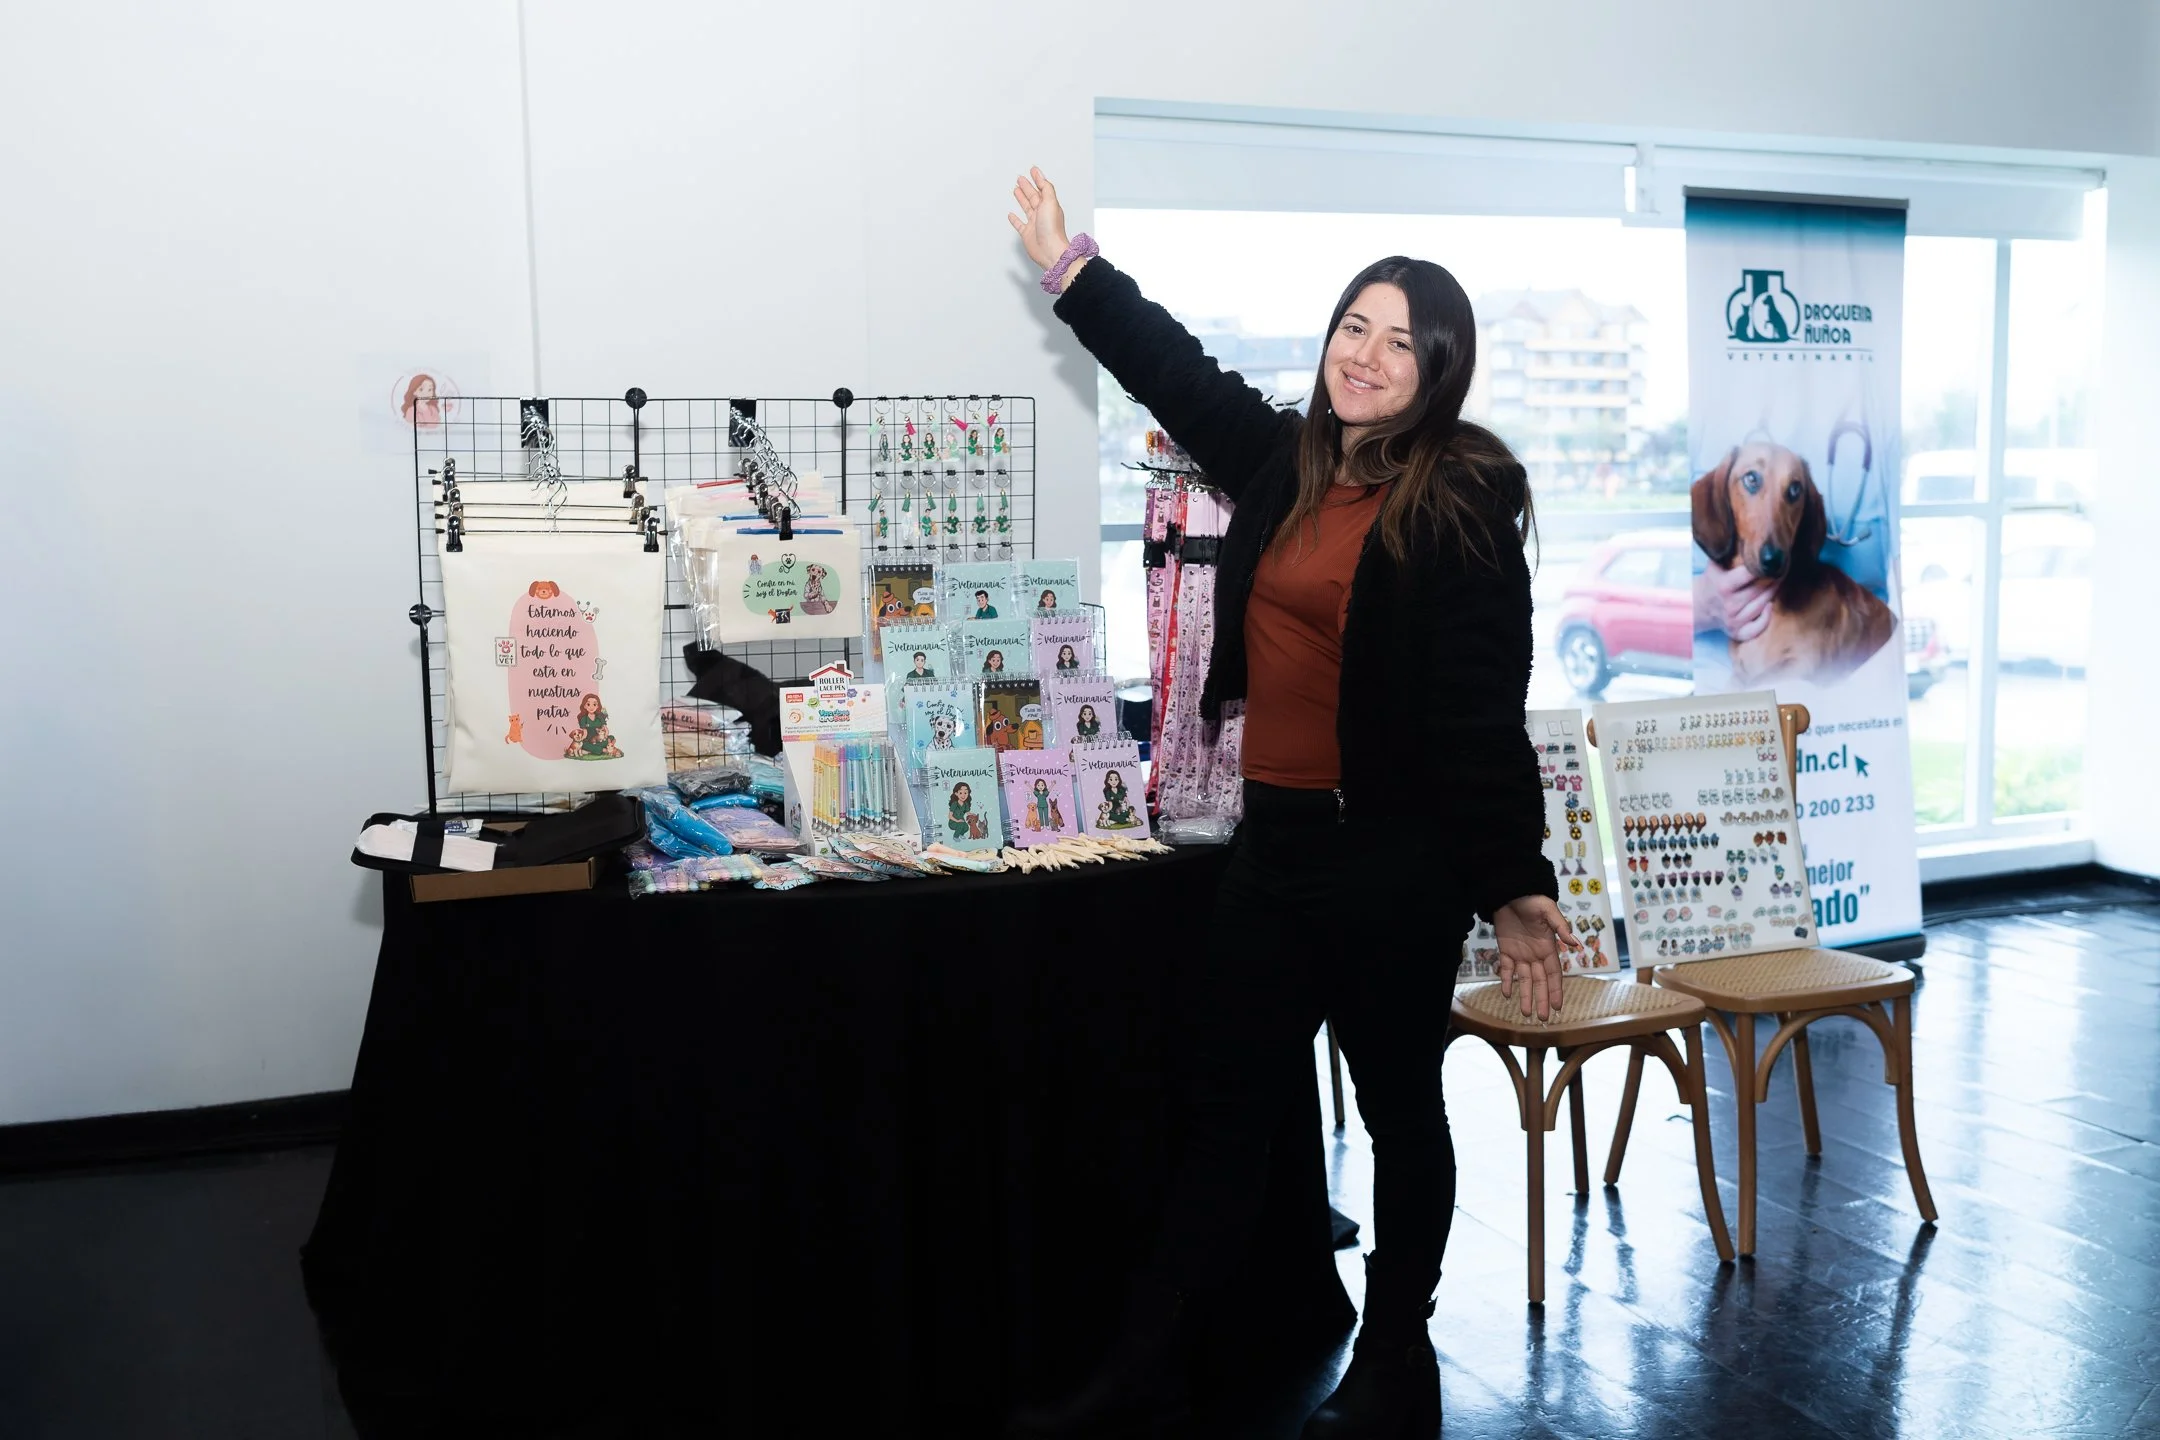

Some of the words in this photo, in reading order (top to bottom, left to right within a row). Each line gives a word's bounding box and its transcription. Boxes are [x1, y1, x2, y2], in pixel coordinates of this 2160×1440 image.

[1805, 324, 1851, 344] ÑUÑOA
[958, 581, 1001, 590] Veterinaria
[1029, 577, 1071, 587] Veterinaria
[528, 604, 576, 618] Estamos
[526, 624, 580, 639] haciendo
[975, 637, 1020, 647] Veterinaria
[1044, 634, 1086, 644] Veterinaria
[894, 642, 940, 652] Veterinaria
[520, 645, 545, 658] todo
[549, 644, 561, 658] lo
[564, 649, 586, 661] que
[561, 668, 576, 678] en
[528, 684, 581, 698] nuestras
[1064, 694, 1109, 704] Veterinaria
[536, 704, 570, 720] patas
[682, 715, 694, 723] en
[1815, 724, 1835, 736] que
[1838, 718, 1890, 732] necesitas
[1088, 759, 1134, 770] Veterinaria
[940, 768, 988, 778] Veterinaria
[1016, 766, 1064, 776] Veterinaria
[1810, 798, 1840, 817] 200
[1846, 794, 1874, 812] 233
